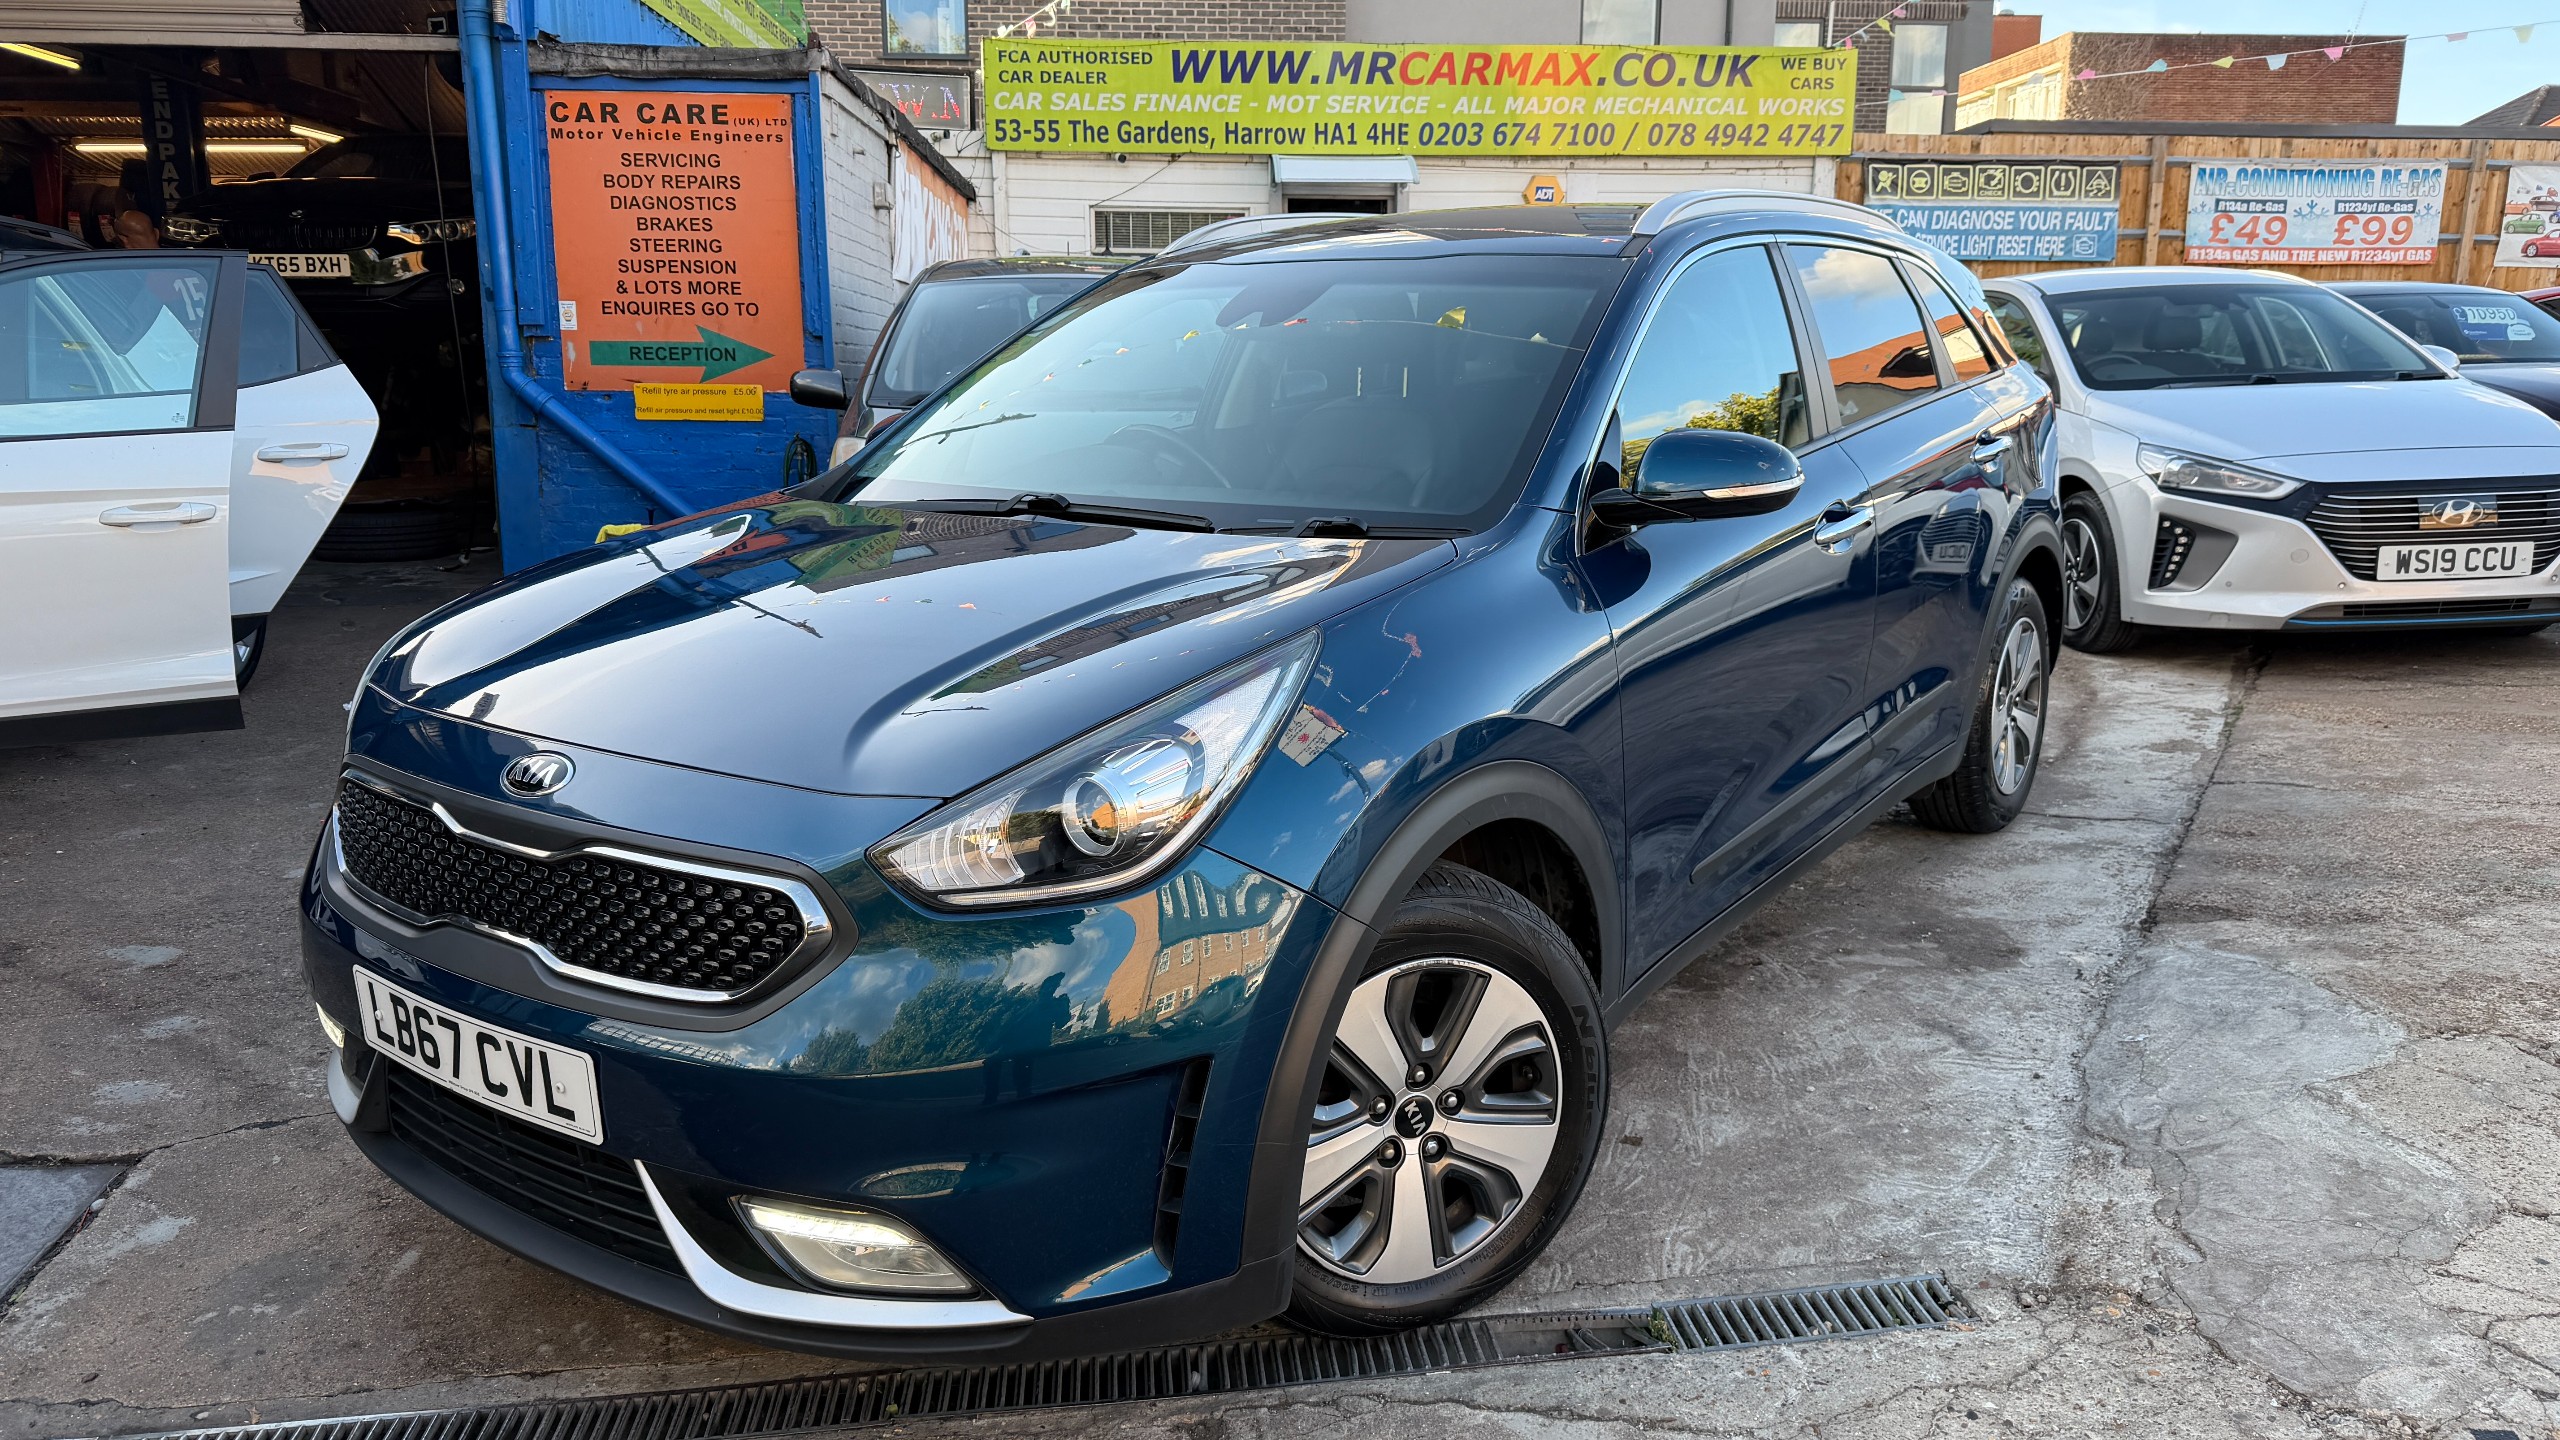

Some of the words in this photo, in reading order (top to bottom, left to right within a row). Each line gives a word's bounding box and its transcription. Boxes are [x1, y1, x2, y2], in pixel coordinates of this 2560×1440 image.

[998, 50, 1031, 63] FCA
[1037, 51, 1153, 65] AUTHORISED
[1781, 58, 1807, 70] WE
[1813, 58, 1847, 71] BUY
[1172, 49, 1760, 87] WWW.MRCARMAX.CO.UK
[999, 70, 1033, 83] CAR
[1040, 71, 1108, 84] DEALER
[1790, 77, 1834, 90] CARS
[993, 92, 1043, 110] CAR
[1050, 92, 1126, 112] SALES
[1133, 93, 1242, 113] FINANCE
[1266, 95, 1321, 113] MOT
[1325, 95, 1430, 114] SERVICE
[1452, 96, 1496, 114] ALL
[1504, 96, 1586, 115] MAJOR
[1593, 96, 1748, 116] MECHANICAL
[1758, 98, 1845, 116] WORKS
[550, 101, 620, 123] CAR
[637, 103, 729, 125] CARE
[734, 117, 760, 127] (UK)
[766, 118, 788, 127] LTD
[150, 74, 181, 199] ENDPAK
[551, 128, 604, 140] Motor
[612, 128, 682, 141] Vehicle
[690, 130, 784, 144] Engineers
[995, 118, 1060, 143] 53-55
[1068, 119, 1109, 144] The
[1117, 119, 1216, 149] Gardens,
[1225, 121, 1306, 145] Harrow
[1314, 122, 1358, 145] HA1
[1366, 122, 1409, 146] 4HE
[1418, 122, 1484, 147] 0203
[1493, 122, 1541, 147] 674
[1550, 122, 1615, 147] 7100
[1647, 123, 1697, 147] 078
[1704, 123, 1770, 147] 4942
[1777, 124, 1845, 148] 4747
[620, 152, 721, 168] SERVICING
[603, 174, 655, 189] BODY
[661, 175, 741, 190] REPAIRS
[2193, 167, 2375, 197] AIR-CONDITIONING
[2380, 168, 2442, 197] RE-GAS
[1535, 188, 1554, 201] ADT
[610, 195, 737, 211] DIAGNOSTICS
[2218, 201, 2247, 212] R134a
[2249, 202, 2285, 212] Re-Gas
[2378, 203, 2414, 212] Re-Gas
[637, 217, 713, 232] BRAKES
[1896, 209, 1928, 229] CAN
[1931, 210, 2015, 231] DIAGNOSE
[2019, 211, 2062, 231] YOUR
[2064, 211, 2114, 231] FAULT
[2208, 213, 2288, 246] £49
[2333, 214, 2413, 246] £99
[629, 238, 722, 253] STEERING
[1960, 234, 1995, 256] LIGHT
[1996, 235, 2034, 256] RESET
[2034, 236, 2066, 256] HERE
[2188, 248, 2231, 260] R134a
[2233, 249, 2259, 260] GAS
[2261, 249, 2289, 261] AND
[2291, 249, 2316, 261] THE
[2318, 249, 2349, 261] NEW
[2406, 249, 2432, 260] GAS
[305, 257, 341, 273] BXH
[618, 259, 737, 274] SUSPENSION
[616, 281, 628, 294] &
[634, 281, 682, 295] LOTS
[688, 281, 742, 296] MORE
[601, 300, 696, 316] ENQUIRES
[701, 302, 729, 316] GO
[735, 302, 759, 317] TO
[630, 346, 736, 362] RECEPTION
[642, 387, 661, 395] Refill
[664, 388, 678, 396] tyre
[680, 387, 690, 395] air
[692, 388, 726, 396] pressure
[2396, 549, 2456, 574] WS19
[2465, 546, 2517, 572] CCU
[368, 981, 461, 1080] LB67
[476, 1031, 576, 1123] CVL
